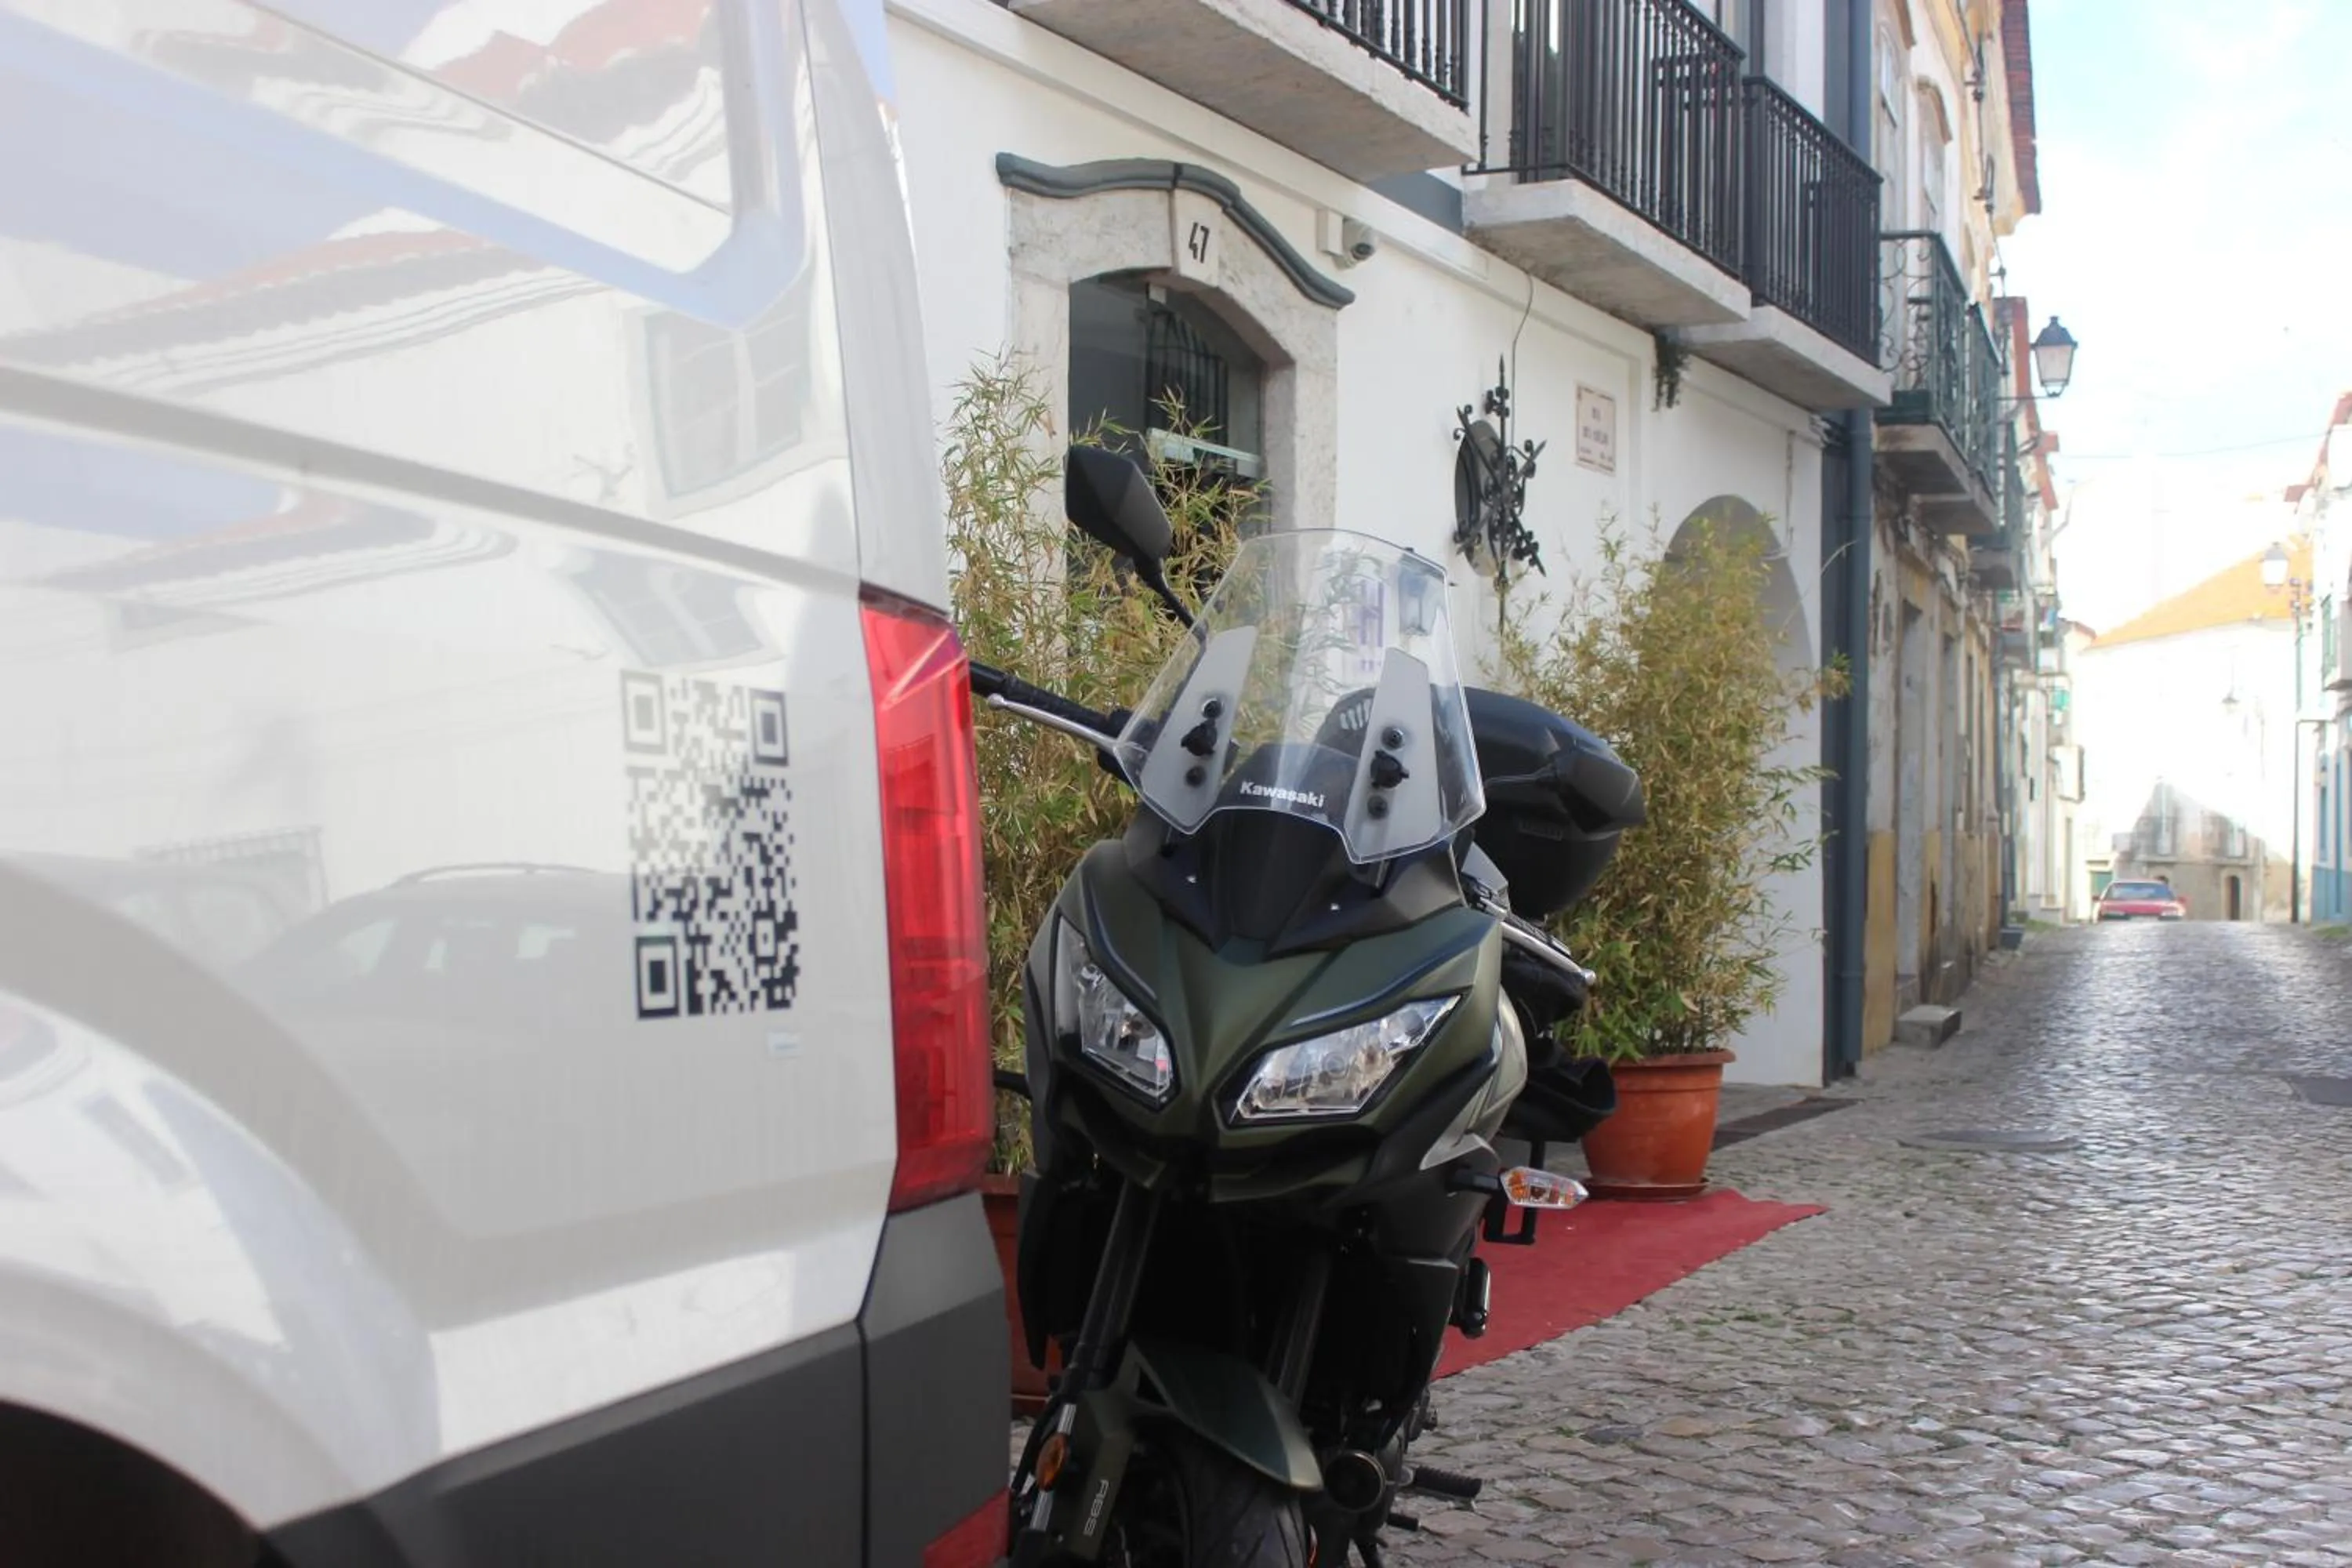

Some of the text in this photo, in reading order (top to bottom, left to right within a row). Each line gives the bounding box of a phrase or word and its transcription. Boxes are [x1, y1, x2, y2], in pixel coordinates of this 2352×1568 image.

[1189, 222, 1210, 264] 47
[1240, 781, 1325, 808] Kawasaki
[1083, 1479, 1109, 1537] ABS
